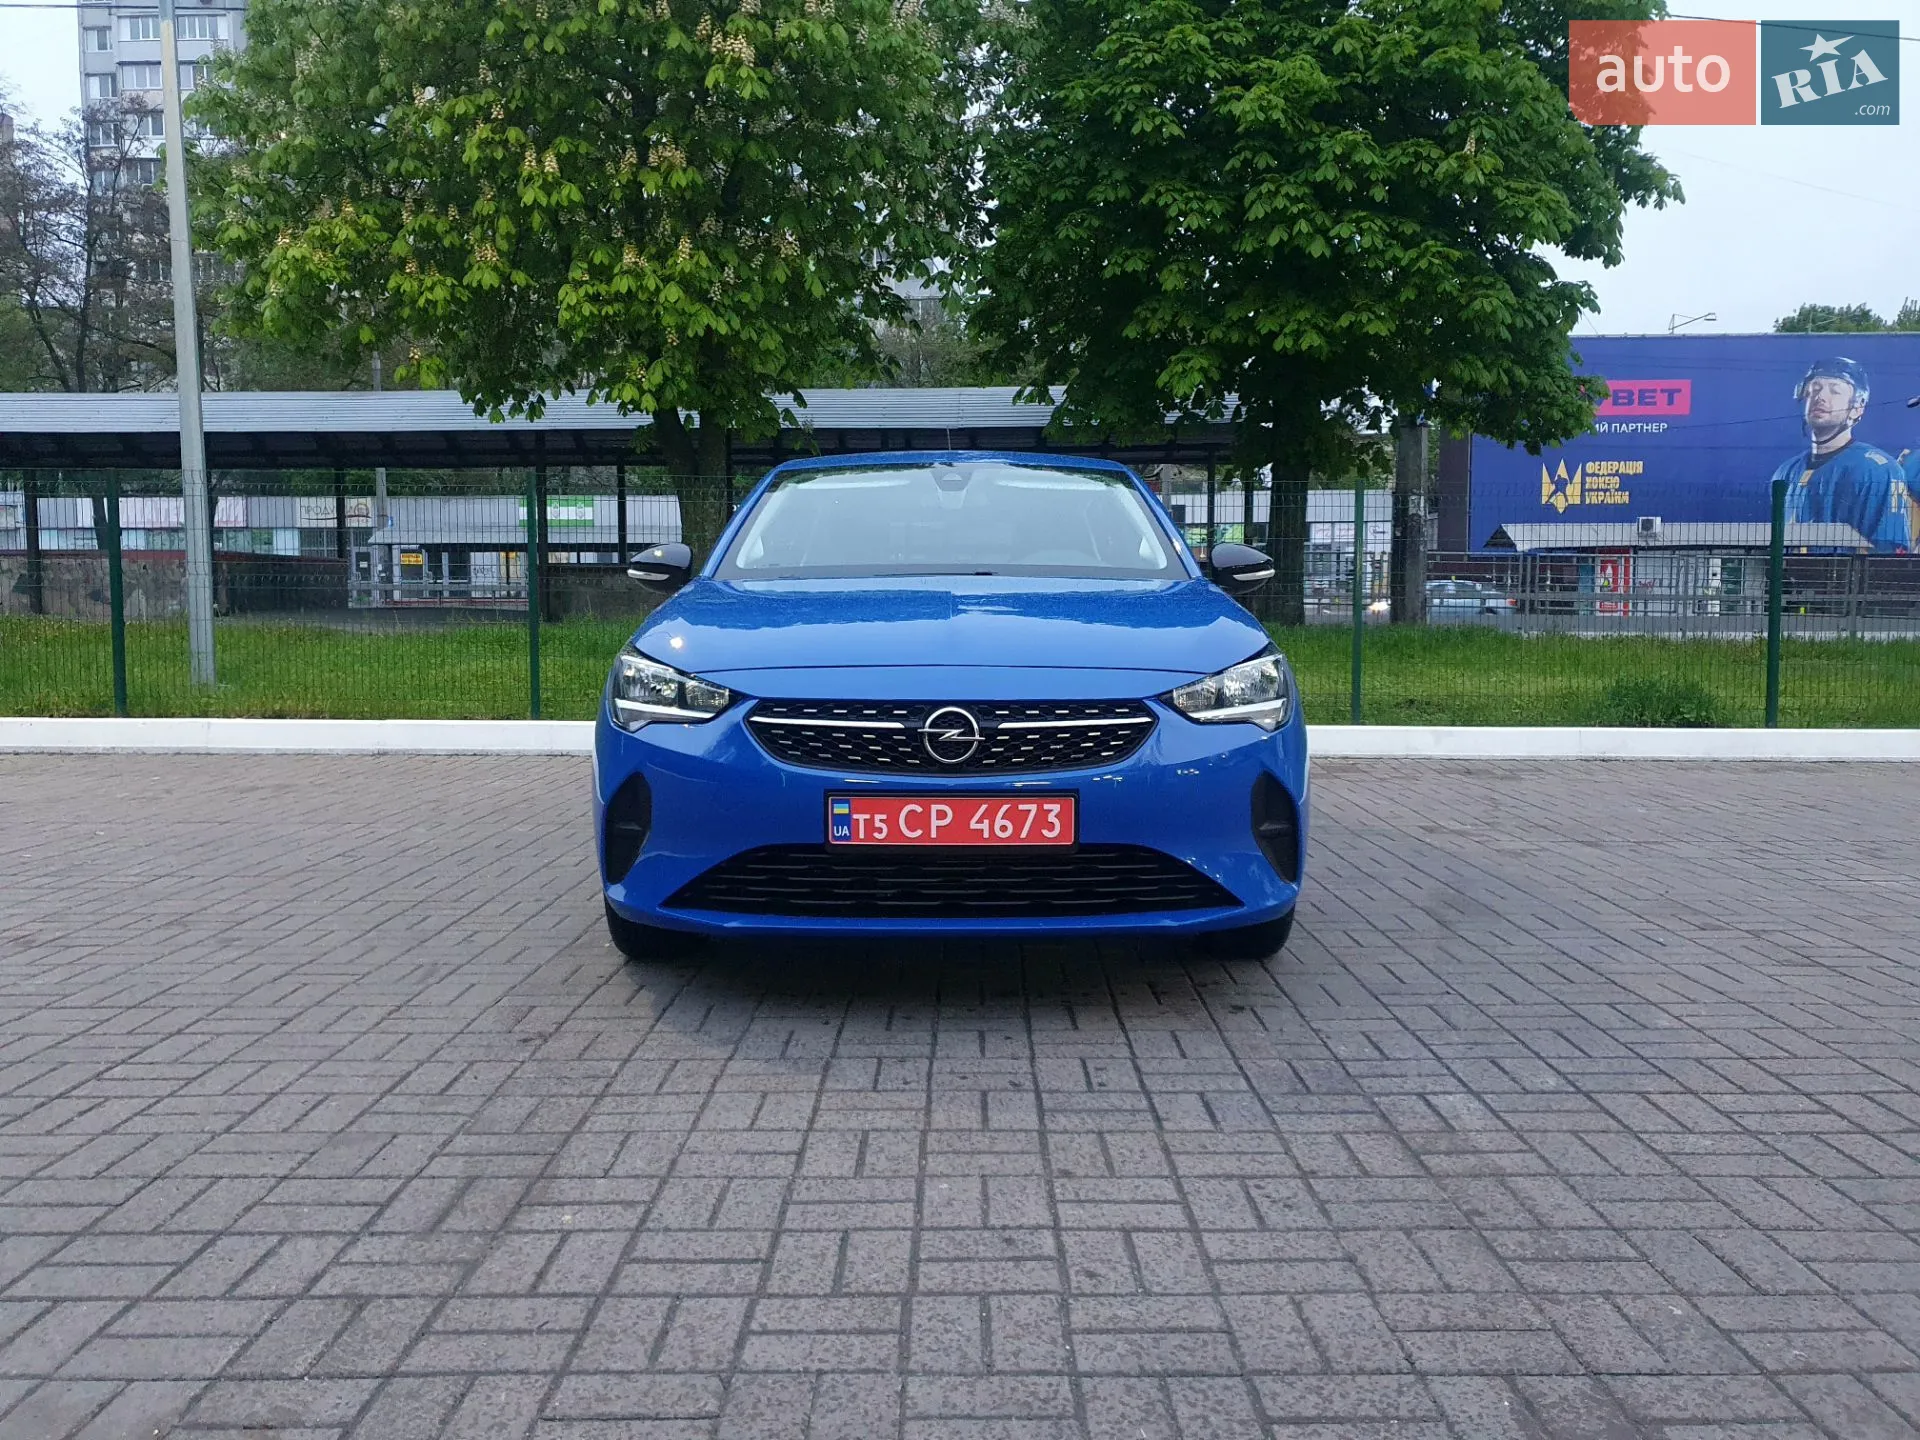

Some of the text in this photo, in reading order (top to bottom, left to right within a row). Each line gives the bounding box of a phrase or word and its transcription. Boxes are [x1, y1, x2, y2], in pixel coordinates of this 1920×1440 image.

[1596, 388, 1682, 407] BET
[1611, 422, 1668, 433] ПАРТНЕР
[1585, 460, 1643, 475] ФЕДЕРАЦІЯ
[1585, 476, 1620, 489] ХОКЕЮ
[1585, 489, 1629, 504] УКРАЇНИ
[852, 803, 1061, 840] T5 CP 4673
[833, 826, 850, 837] UA
